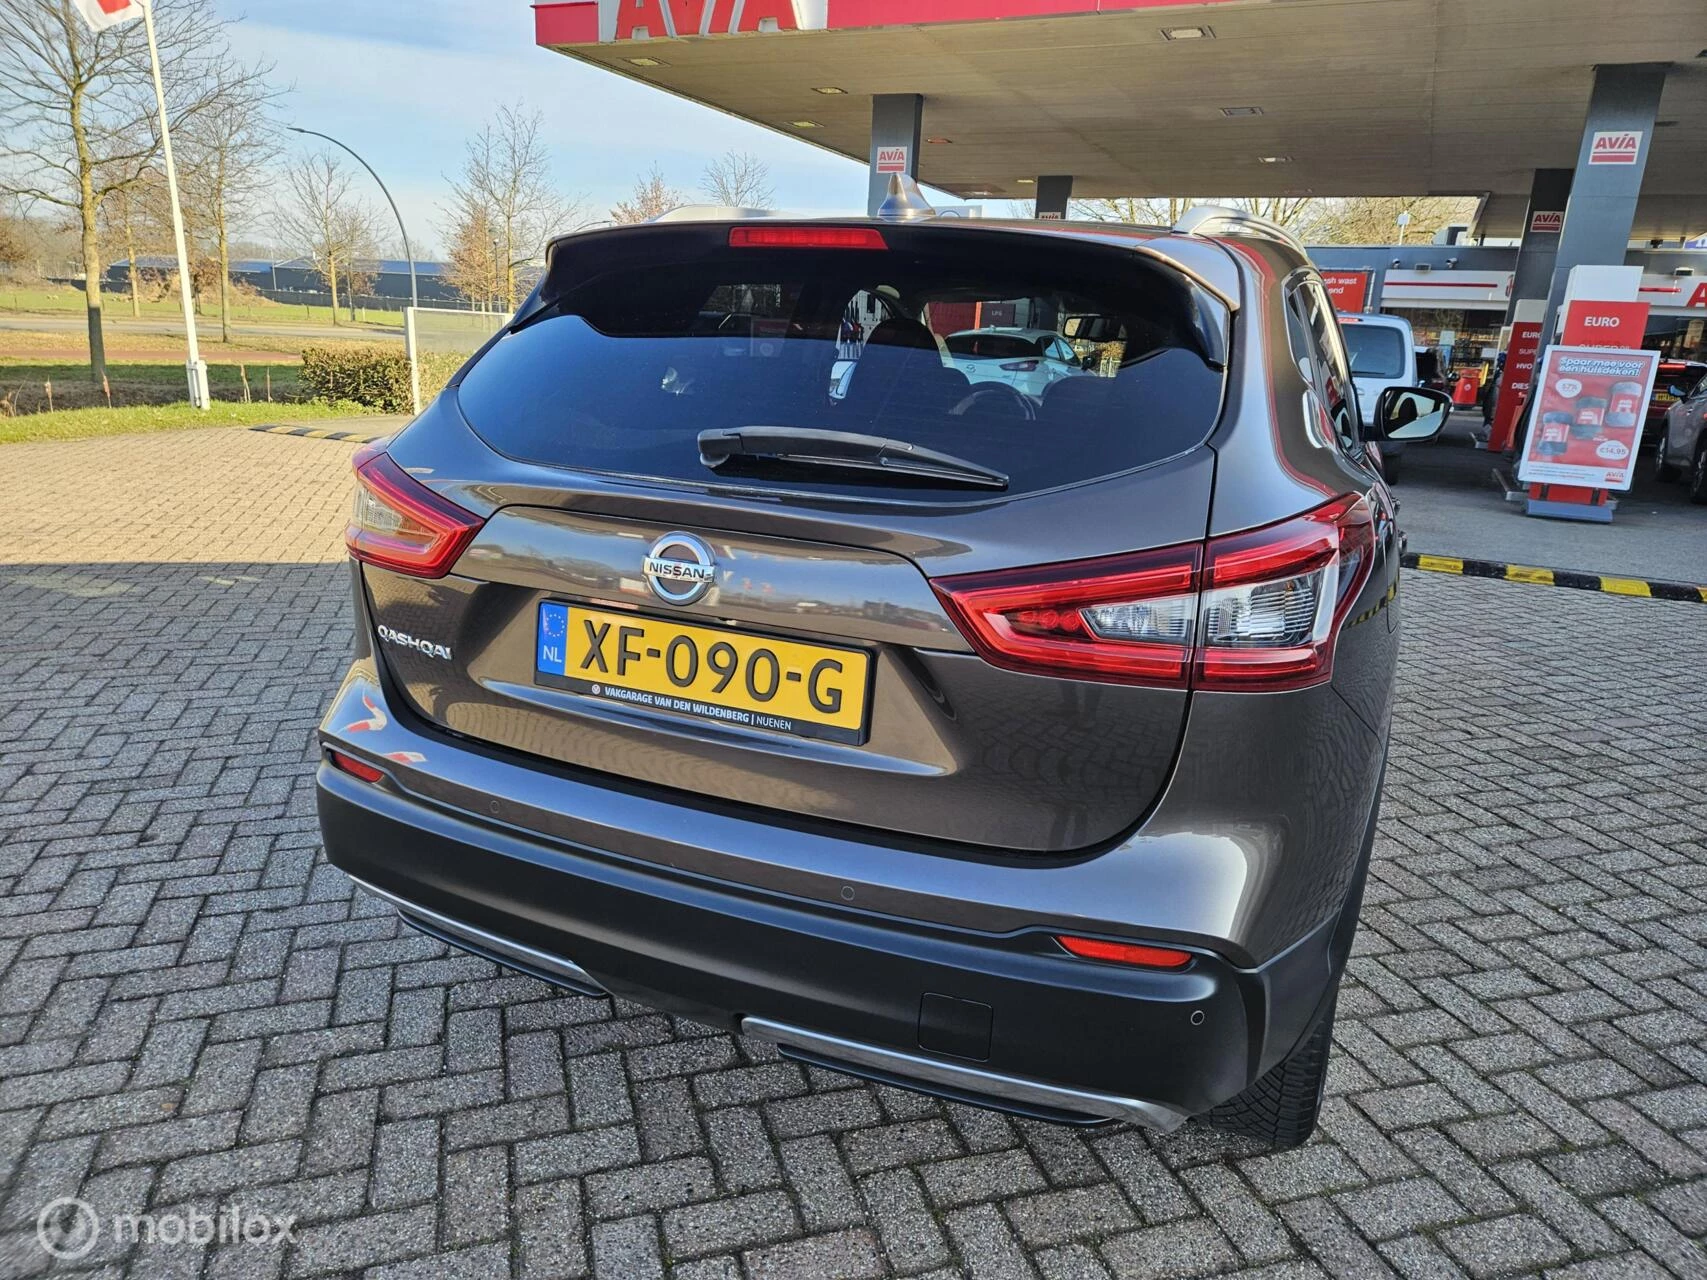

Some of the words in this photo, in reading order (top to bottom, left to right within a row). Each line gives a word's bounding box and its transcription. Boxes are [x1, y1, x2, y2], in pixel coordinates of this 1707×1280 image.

[1594, 133, 1637, 150] AVIA
[879, 148, 905, 161] AVIA
[1534, 213, 1561, 223] AVIA
[1583, 316, 1620, 327] EURO
[1560, 357, 1592, 368] Spaar
[1618, 361, 1644, 369] voor
[649, 561, 705, 578] NISSAN
[377, 624, 452, 660] QASHQAI
[543, 645, 562, 663] NL
[580, 619, 843, 714] XF-090-G
[604, 686, 653, 704] VAKGARAGE
[654, 696, 672, 708] VAN
[673, 699, 691, 712] DEN
[692, 703, 750, 723] WILDENBERG
[756, 717, 792, 731] NUENEN
